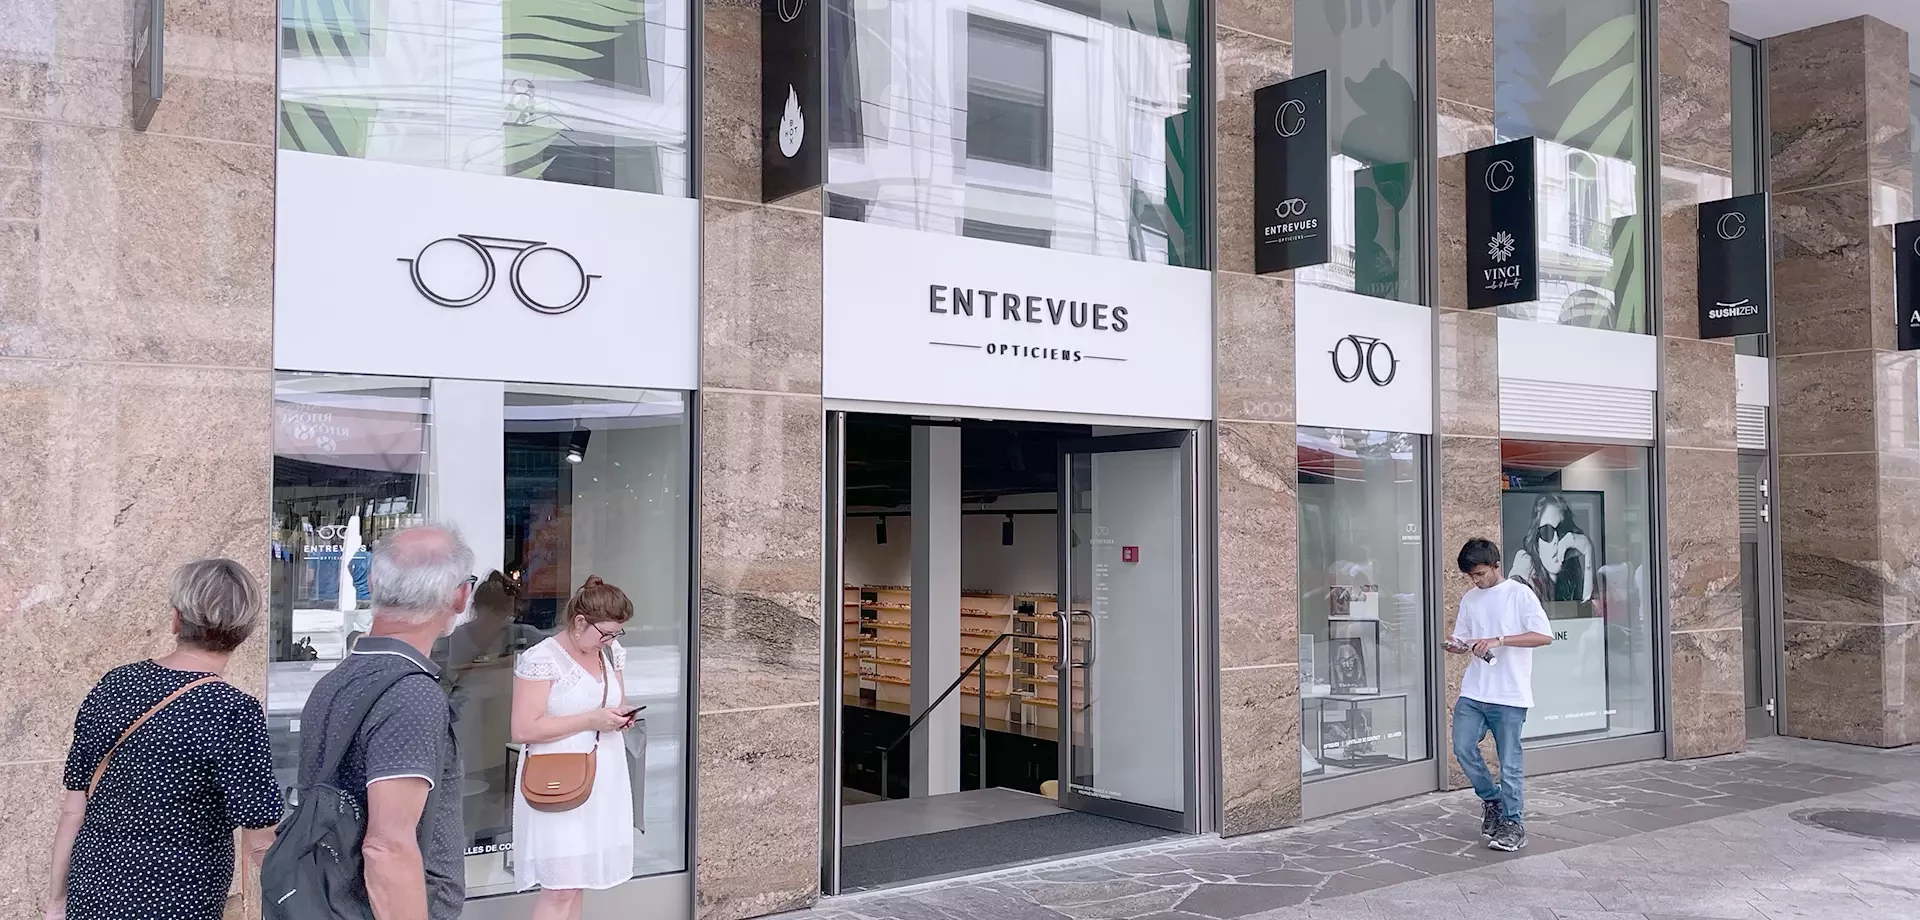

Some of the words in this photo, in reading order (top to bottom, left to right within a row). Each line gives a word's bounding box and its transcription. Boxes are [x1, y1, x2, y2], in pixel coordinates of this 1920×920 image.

[1264, 218, 1318, 236] ENTREVUES
[1483, 264, 1521, 281] VINCI
[929, 284, 1129, 333] ENTREVUES
[1708, 305, 1759, 319] SUSHIZEN
[986, 343, 1082, 362] OPTICIENS
[304, 544, 367, 553] ENTREVS
[485, 844, 498, 853] DE
[499, 842, 514, 851] CO
